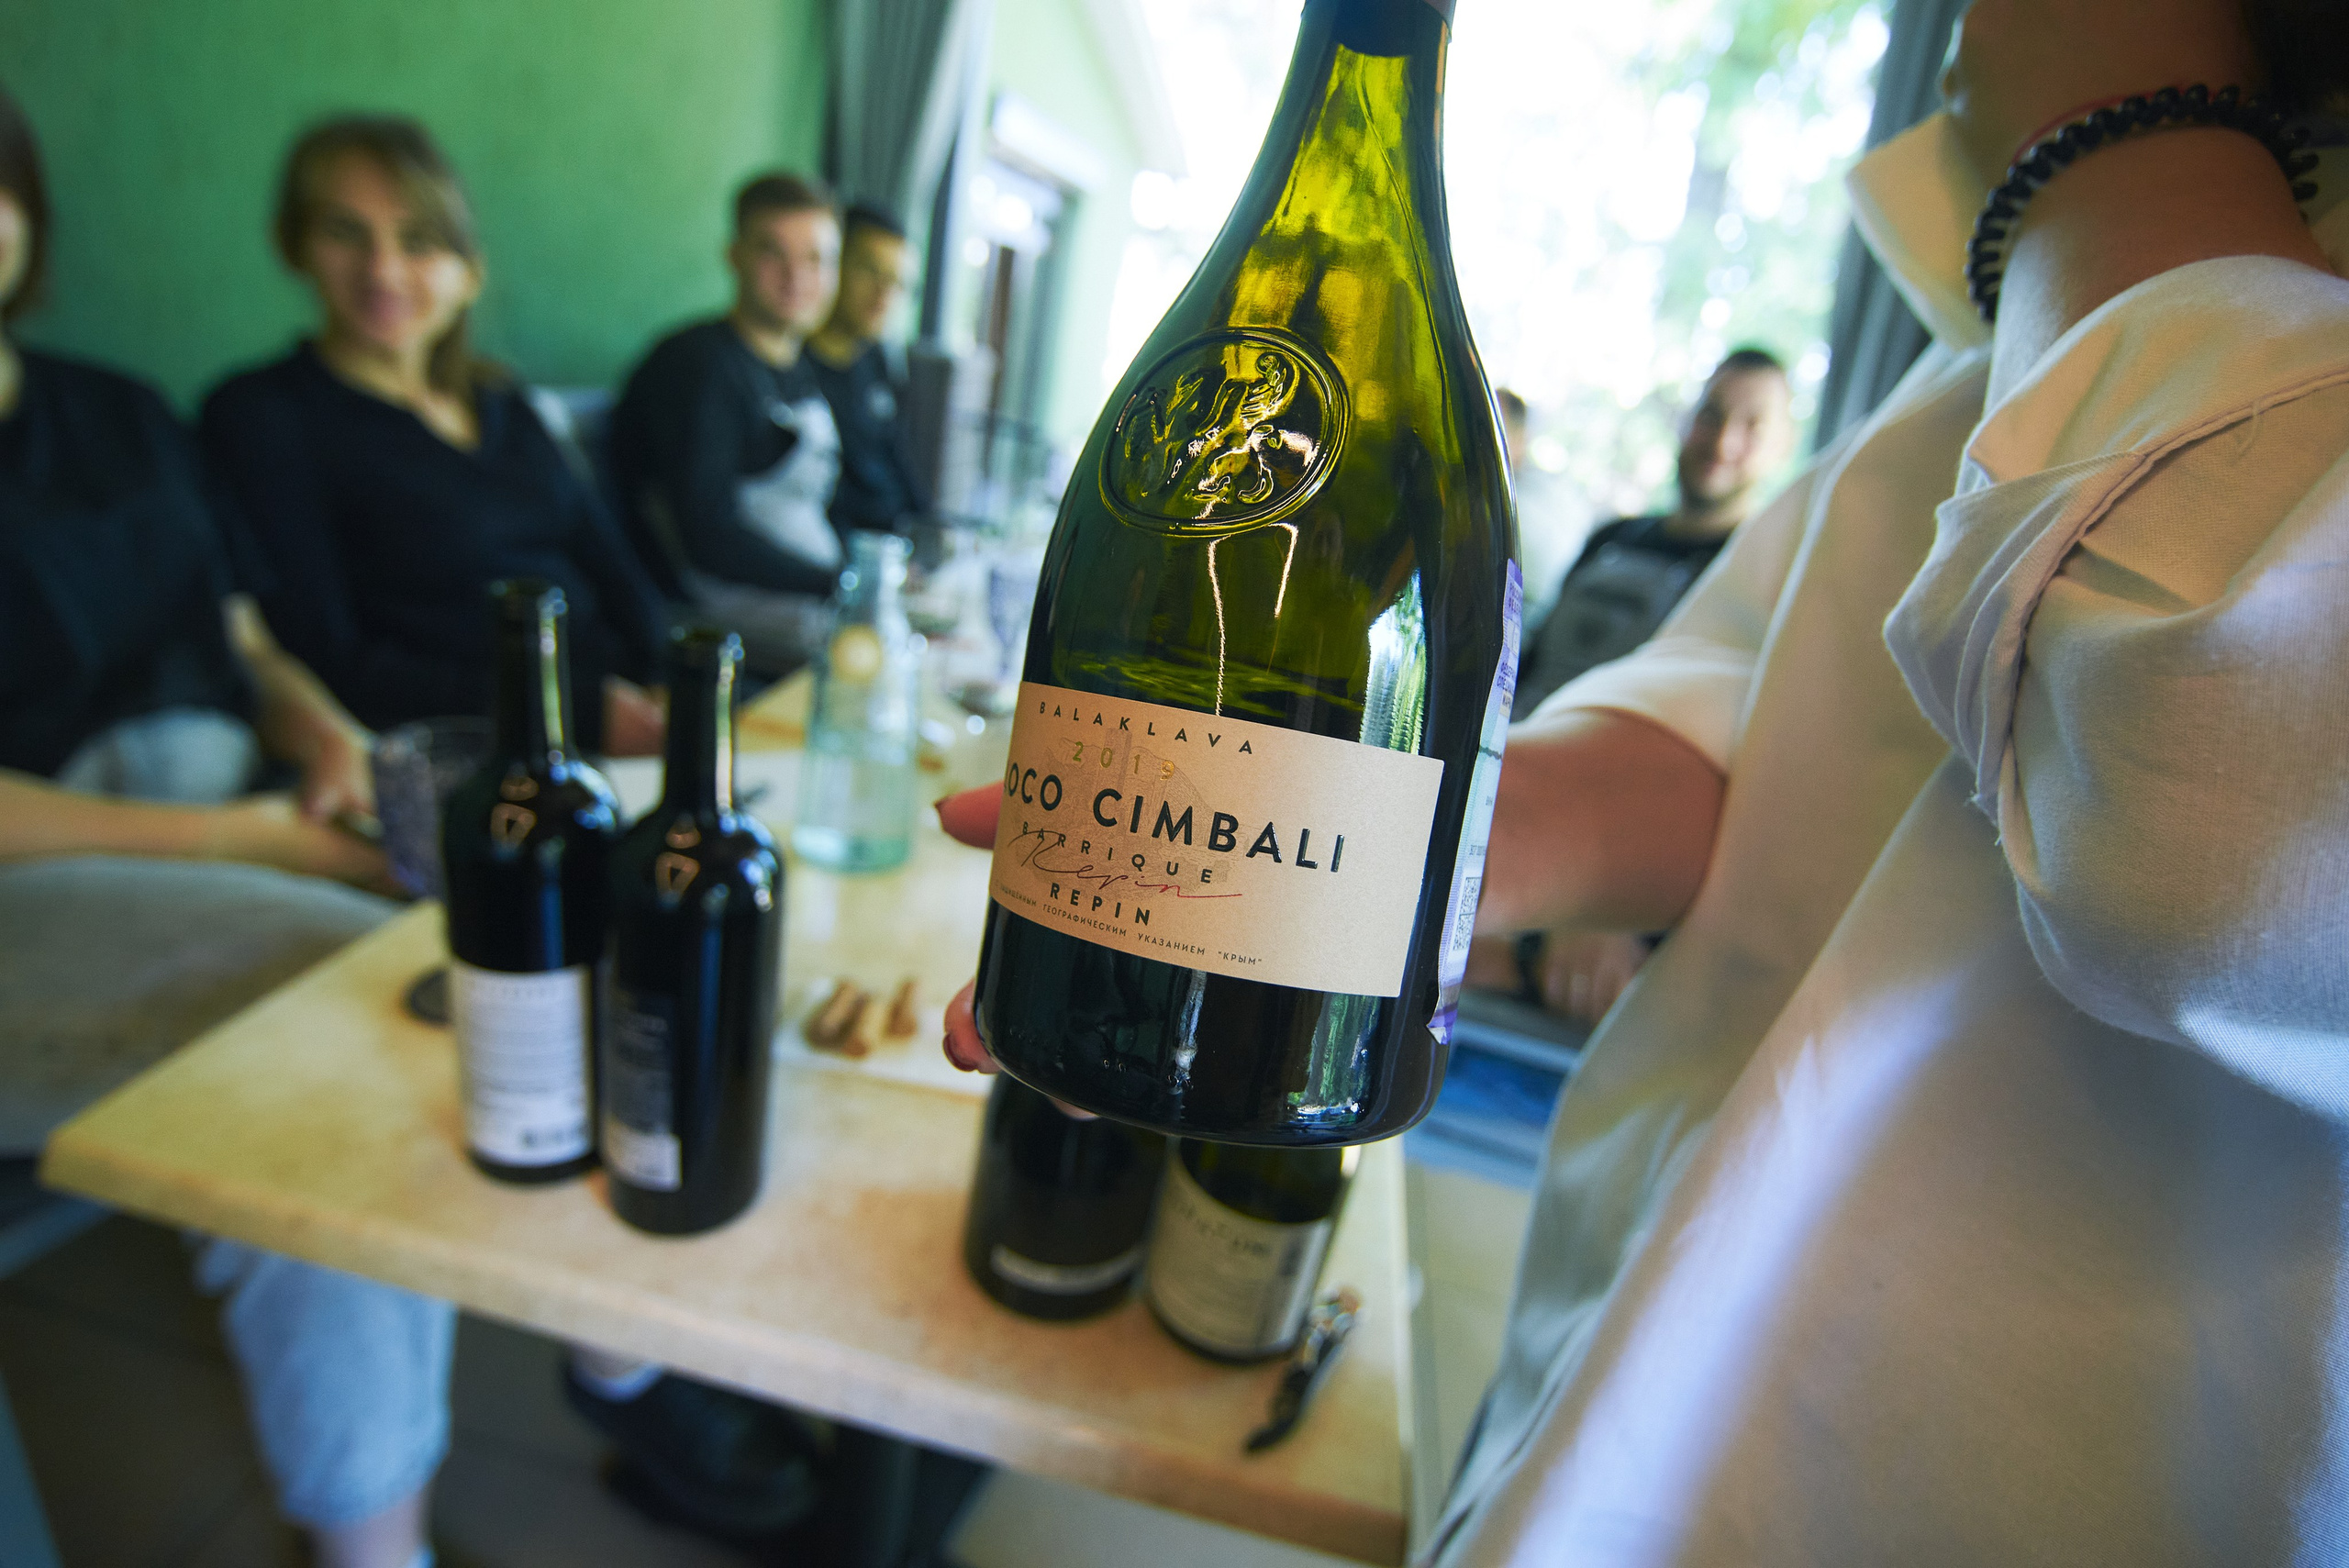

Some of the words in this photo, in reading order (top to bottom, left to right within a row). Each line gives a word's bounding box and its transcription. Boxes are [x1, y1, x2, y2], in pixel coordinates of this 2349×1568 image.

[1039, 701, 1252, 755] BALAKLAVA
[1072, 740, 1175, 781] 2019
[1004, 762, 1063, 811] OCO
[1093, 788, 1345, 873] CIMBALI
[1022, 821, 1213, 884] BARRIQUE
[1042, 904, 1128, 937] ГЕОГРАФИЧЕСКИМ
[1138, 932, 1206, 955] УКАЗАНИЕМ
[1050, 883, 1151, 927] REPIN
